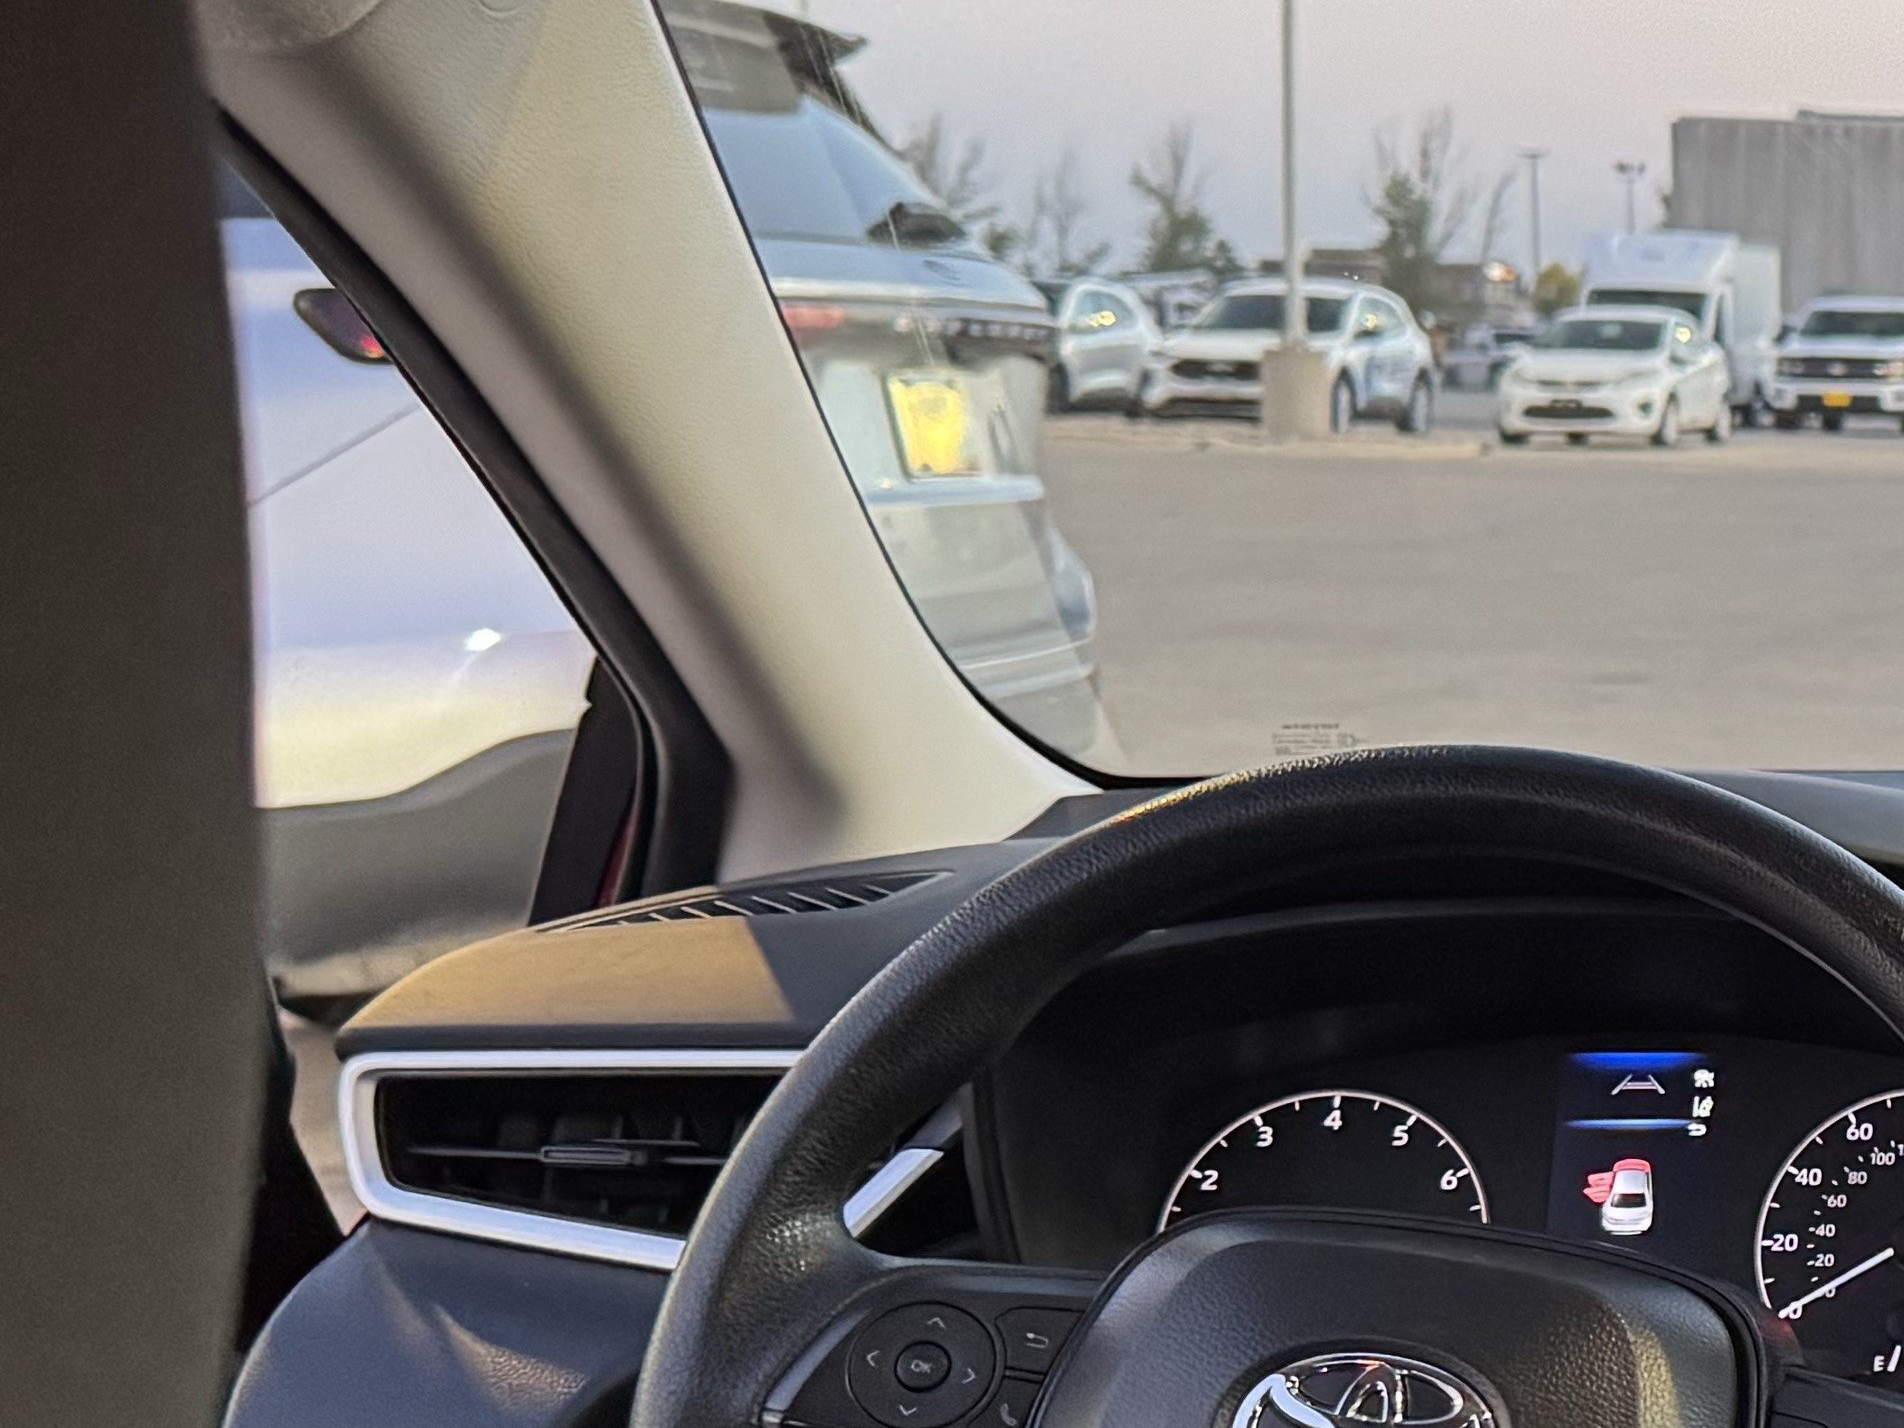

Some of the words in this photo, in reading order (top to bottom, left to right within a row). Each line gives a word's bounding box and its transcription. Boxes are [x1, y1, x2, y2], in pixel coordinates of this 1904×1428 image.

[1323, 1109, 1343, 1130] 4
[1256, 1126, 1273, 1147] 3
[1391, 1125, 1409, 1146] 5
[1846, 1123, 1874, 1141] 60
[1870, 1151, 1896, 1165] 100
[1201, 1169, 1219, 1191] 2
[1440, 1169, 1458, 1191] 6
[1795, 1168, 1822, 1186] 40
[1847, 1171, 1868, 1185] 80
[1827, 1194, 1848, 1208] 60
[1815, 1223, 1836, 1237] 40
[1770, 1234, 1799, 1252] 20
[1814, 1253, 1835, 1268] 20
[911, 1359, 932, 1373] OK
[1873, 1355, 1885, 1372] E
